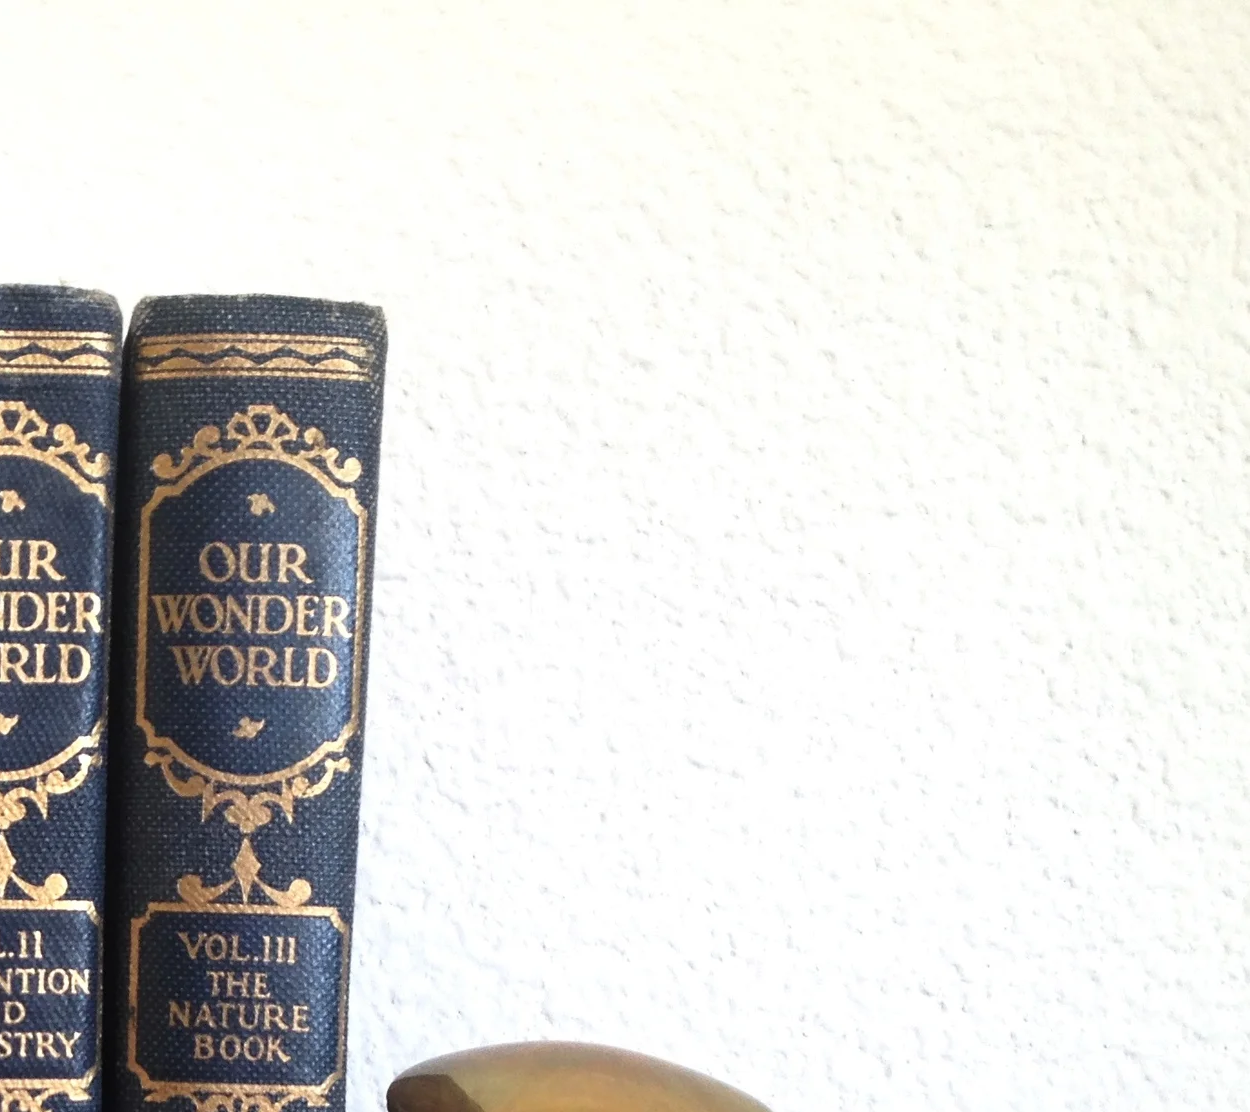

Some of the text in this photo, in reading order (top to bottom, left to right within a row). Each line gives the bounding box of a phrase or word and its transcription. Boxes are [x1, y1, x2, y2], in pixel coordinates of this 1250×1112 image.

[198, 541, 314, 584] OUR
[153, 594, 352, 638] WONDER
[168, 644, 338, 687] WORLD
[206, 971, 271, 999] THE
[168, 1000, 311, 1032] NATURE
[193, 1033, 292, 1063] BOOK
